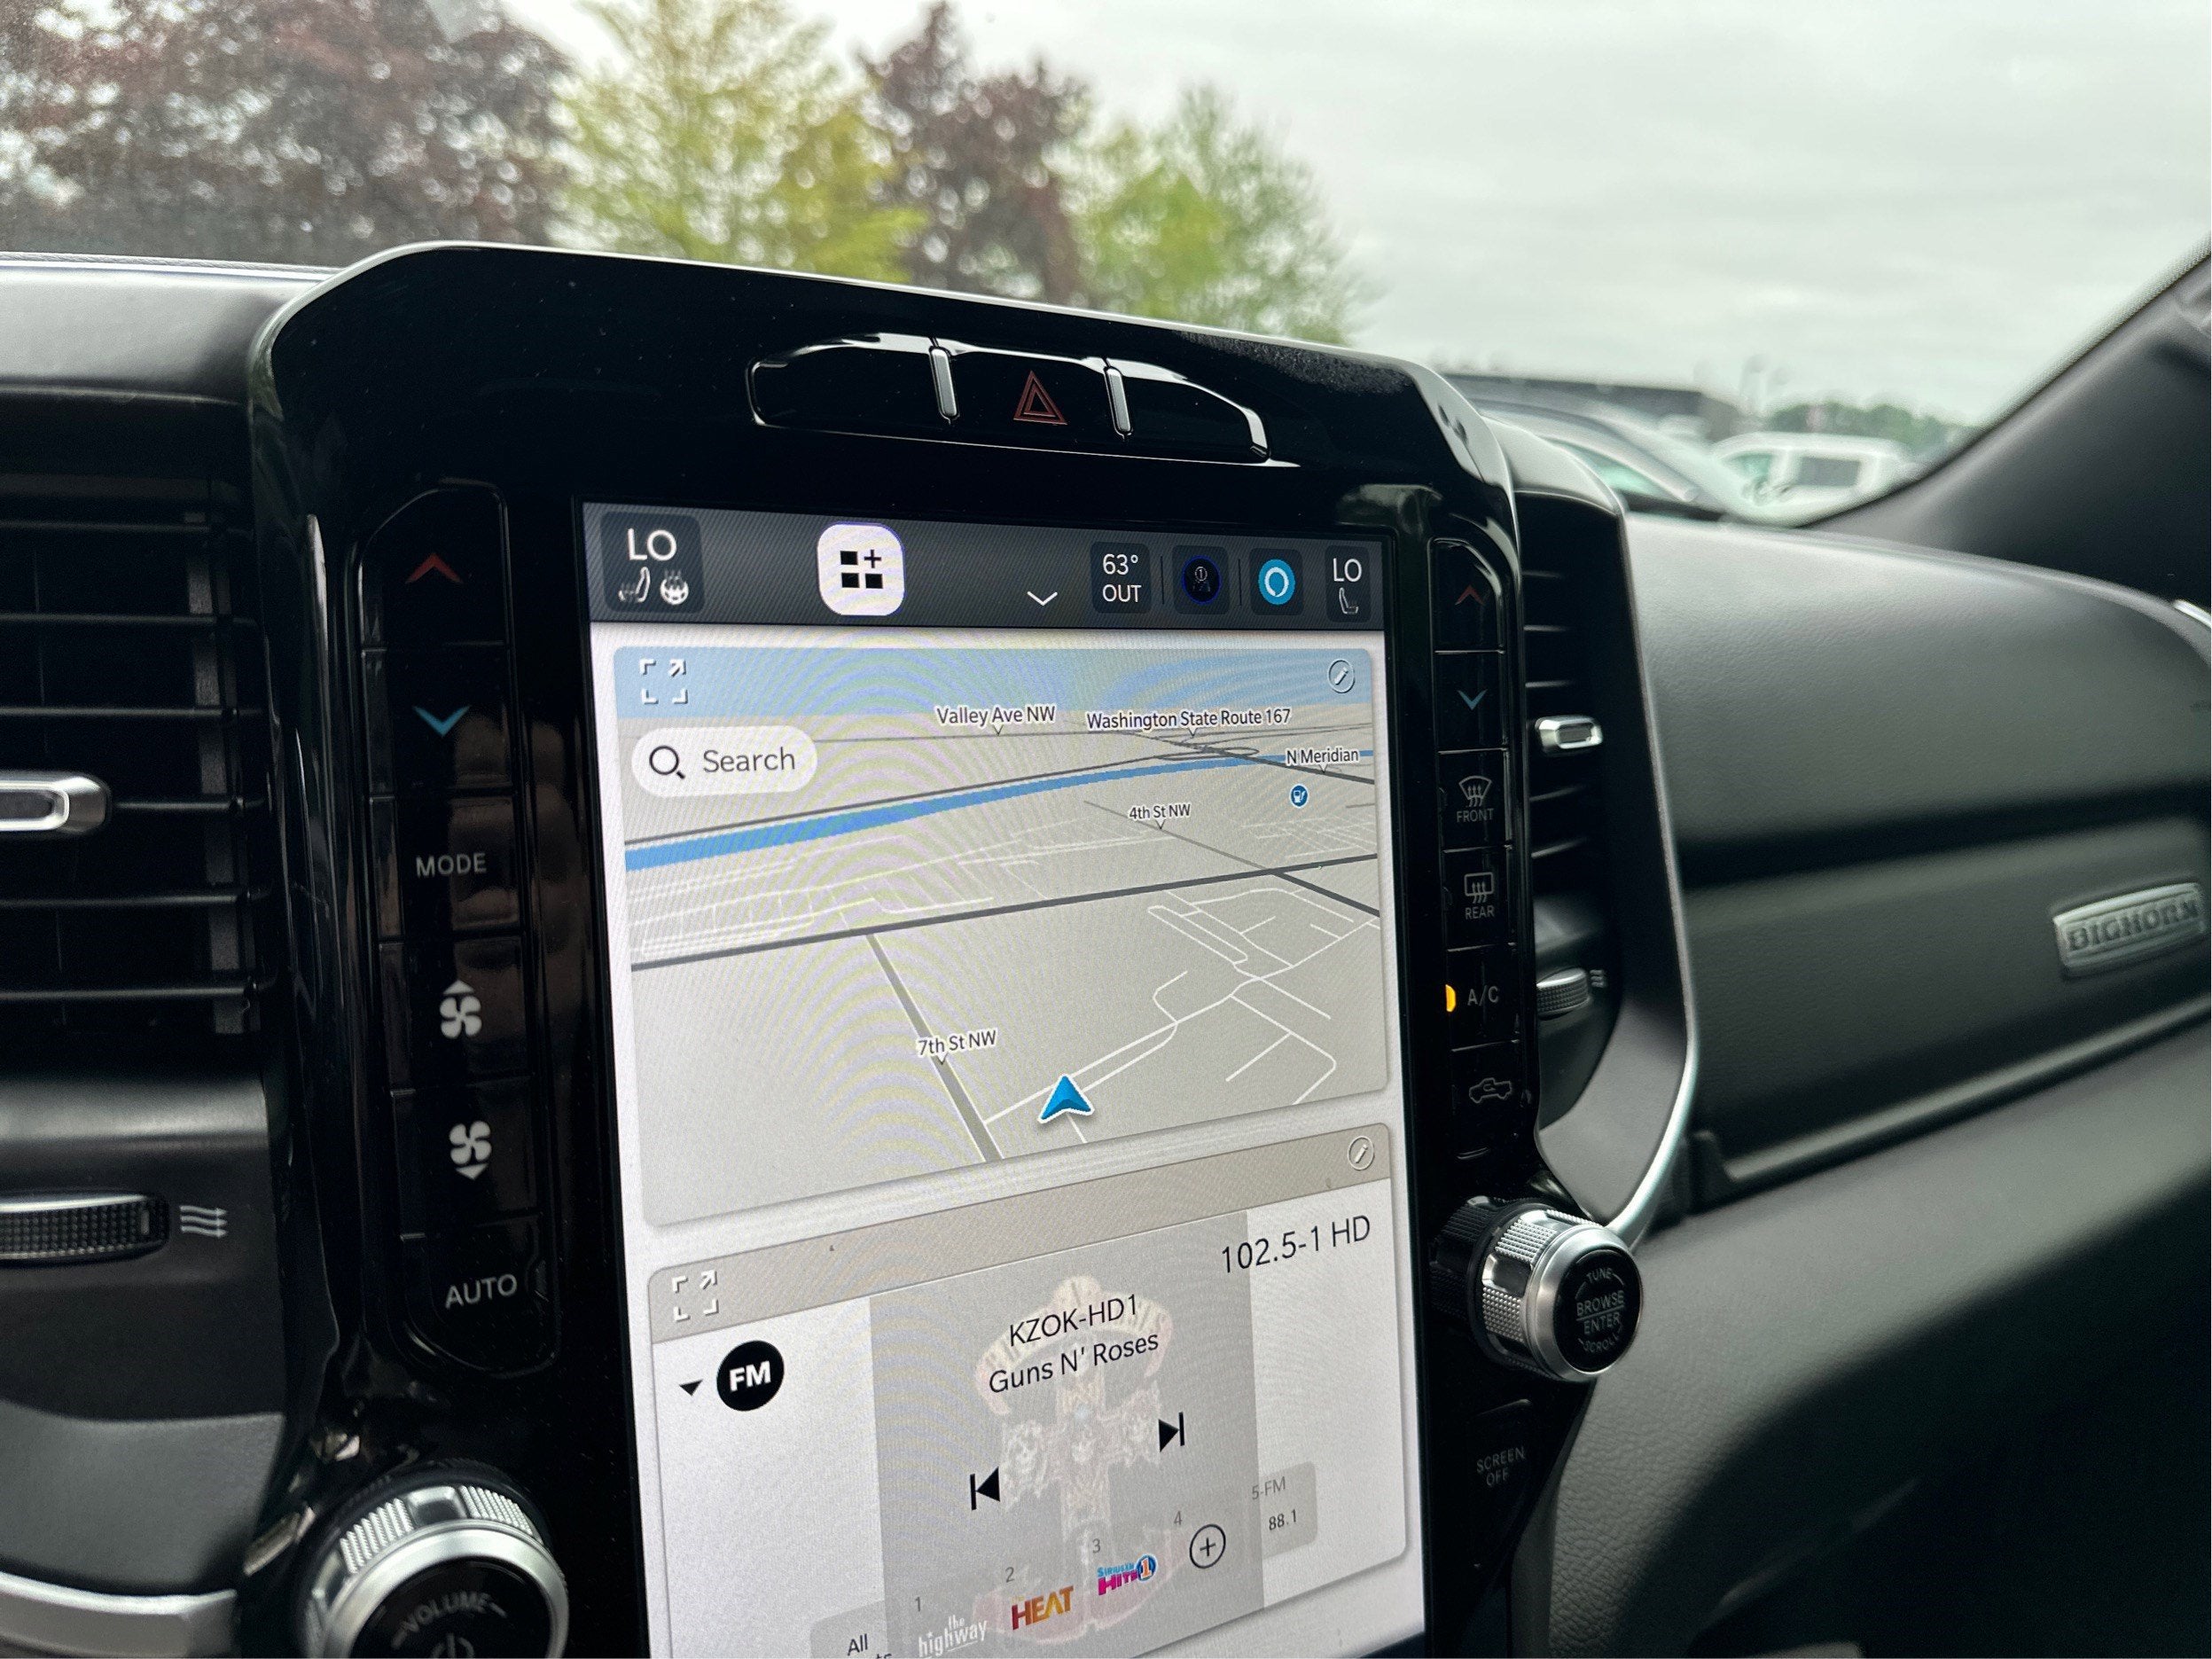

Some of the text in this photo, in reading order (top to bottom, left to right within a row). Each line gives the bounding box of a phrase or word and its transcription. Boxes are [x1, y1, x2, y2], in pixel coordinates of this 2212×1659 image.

[627, 528, 677, 561] LO
[1102, 553, 1139, 575] 63°
[1333, 558, 1363, 583] LO
[1102, 584, 1141, 603] OUT
[936, 706, 1056, 727] Valley Ave NW
[1086, 708, 1291, 731] Washington State Route 167
[702, 747, 796, 774] Search
[1286, 748, 1359, 764] N Meridian
[1129, 804, 1191, 819] 4th St NW
[1456, 808, 1495, 823] FRONT
[416, 852, 488, 879] MODE
[1465, 904, 1495, 919] REAR
[1467, 985, 1499, 1006] A/C
[918, 1029, 997, 1056] 7th St NW
[1222, 1214, 1371, 1273] 102.5-1 HD
[1586, 1267, 1613, 1284] TUNE
[445, 1273, 518, 1310] AUTO
[1577, 1290, 1624, 1317] BROWSE
[1010, 1294, 1137, 1347] KZOK-HD1
[1583, 1312, 1621, 1335] ENTER
[989, 1334, 1159, 1393] Guns N' Roses
[729, 1359, 771, 1392] FM
[1476, 1446, 1526, 1473] SCREEN
[1251, 1475, 1286, 1500] 5-FM
[1486, 1467, 1509, 1487] OFF
[1173, 1510, 1183, 1526] 4
[1268, 1508, 1297, 1531] 88.1
[1091, 1538, 1101, 1553] 3
[1004, 1566, 1014, 1583] 2
[914, 1596, 921, 1612] 1
[1012, 1585, 1075, 1631] HEAT
[948, 1614, 965, 1632] the
[847, 1632, 868, 1656] All
[918, 1620, 988, 1658] highway
